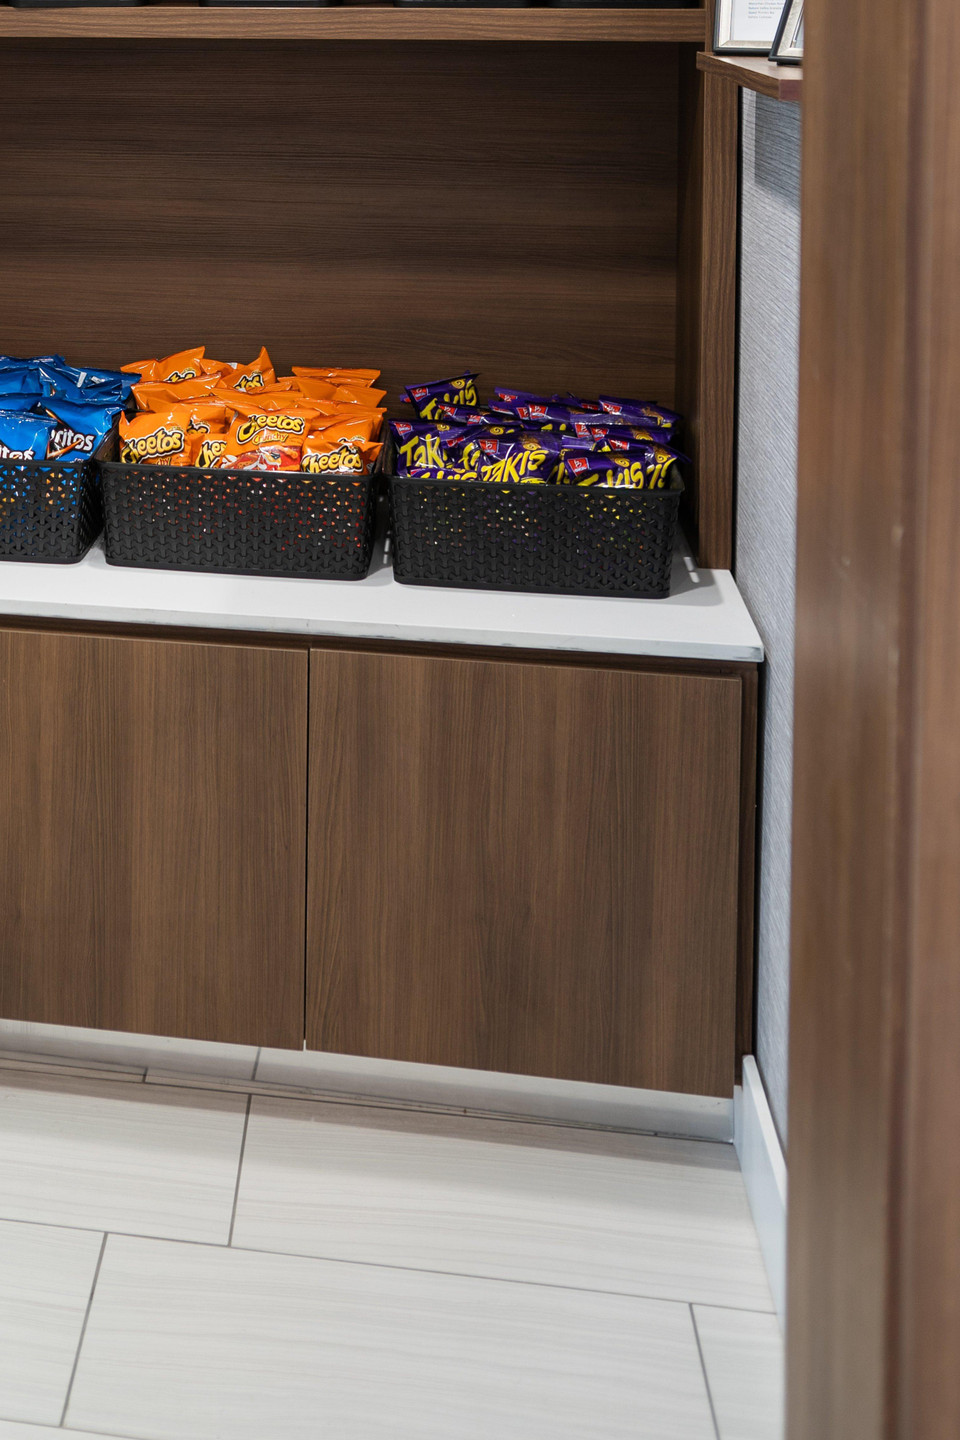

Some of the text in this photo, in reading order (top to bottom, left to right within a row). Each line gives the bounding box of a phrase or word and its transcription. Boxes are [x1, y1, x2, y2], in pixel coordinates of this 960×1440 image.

[237, 413, 306, 445] Cheetos
[122, 427, 185, 464] Cheetos
[301, 444, 363, 474] Cheetos
